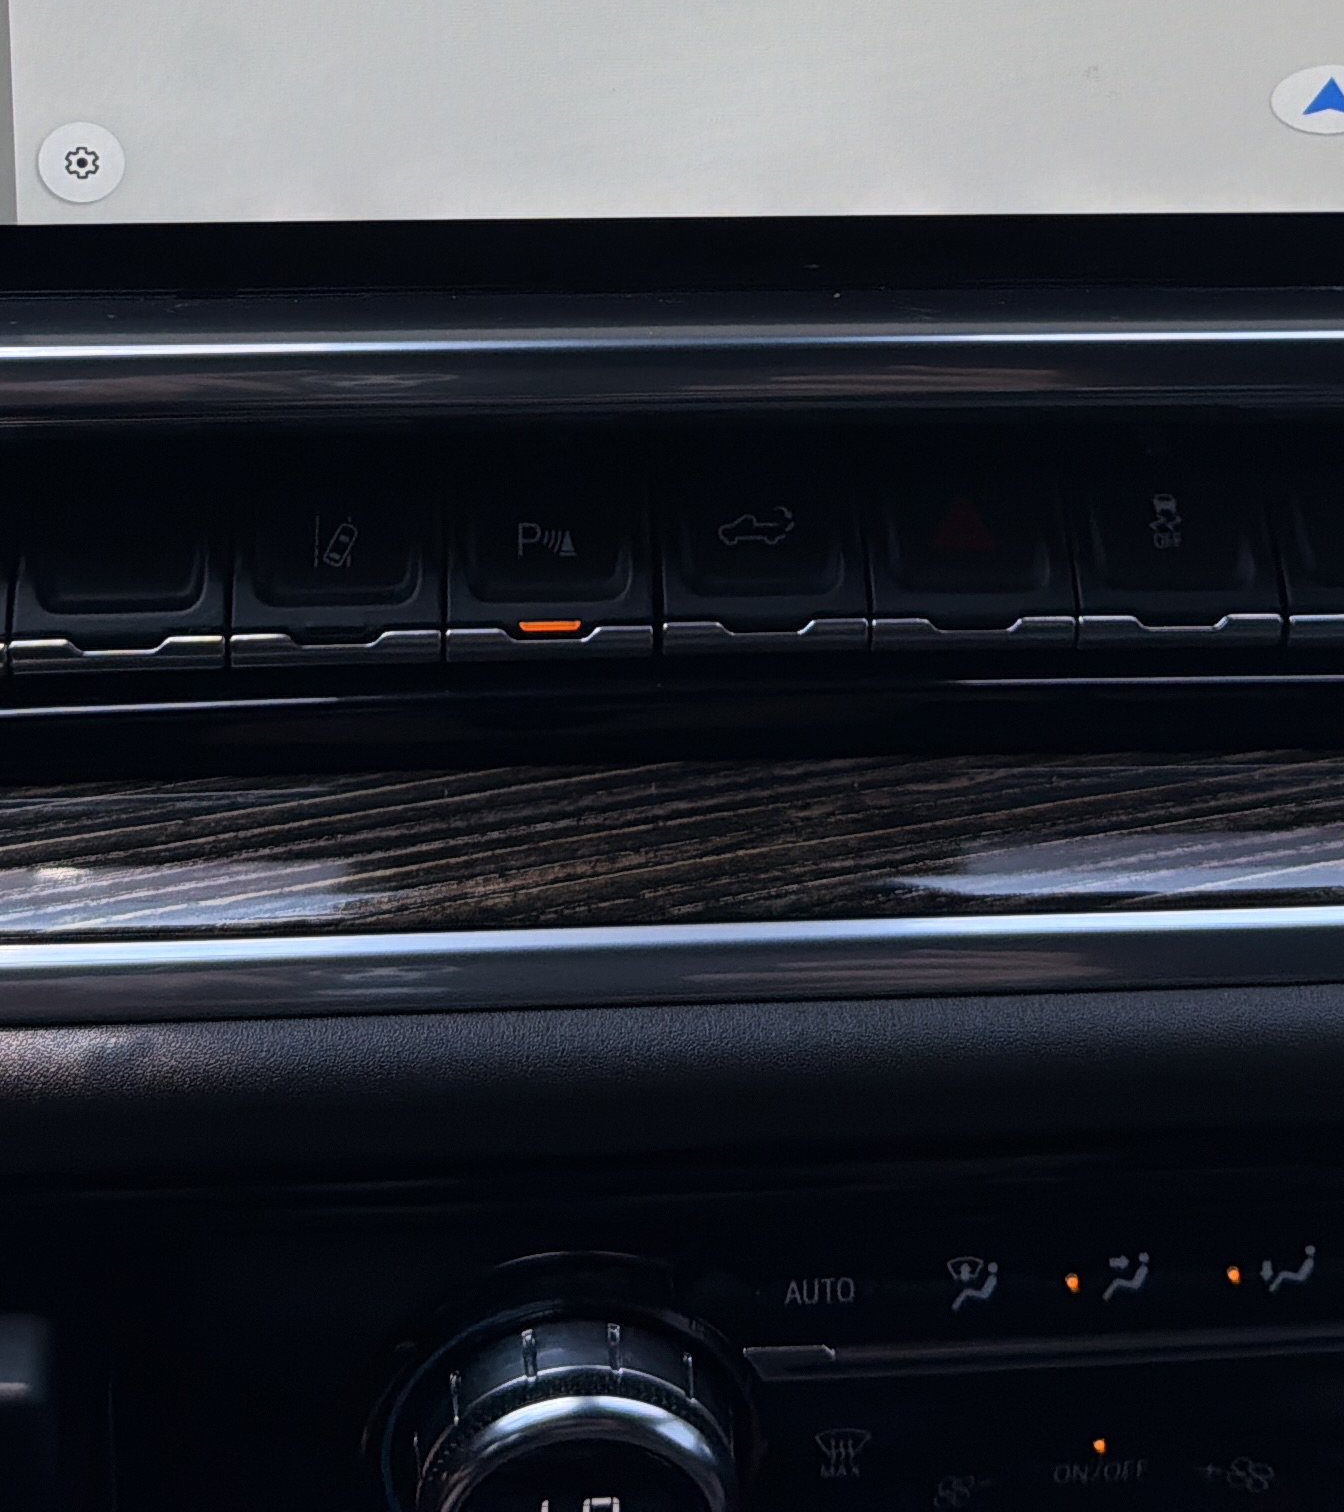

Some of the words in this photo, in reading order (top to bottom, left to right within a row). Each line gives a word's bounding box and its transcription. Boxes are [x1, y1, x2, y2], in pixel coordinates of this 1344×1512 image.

[784, 1277, 855, 1306] AUTO
[820, 1464, 861, 1479] MAX
[1052, 1459, 1148, 1486] ON/OFF
